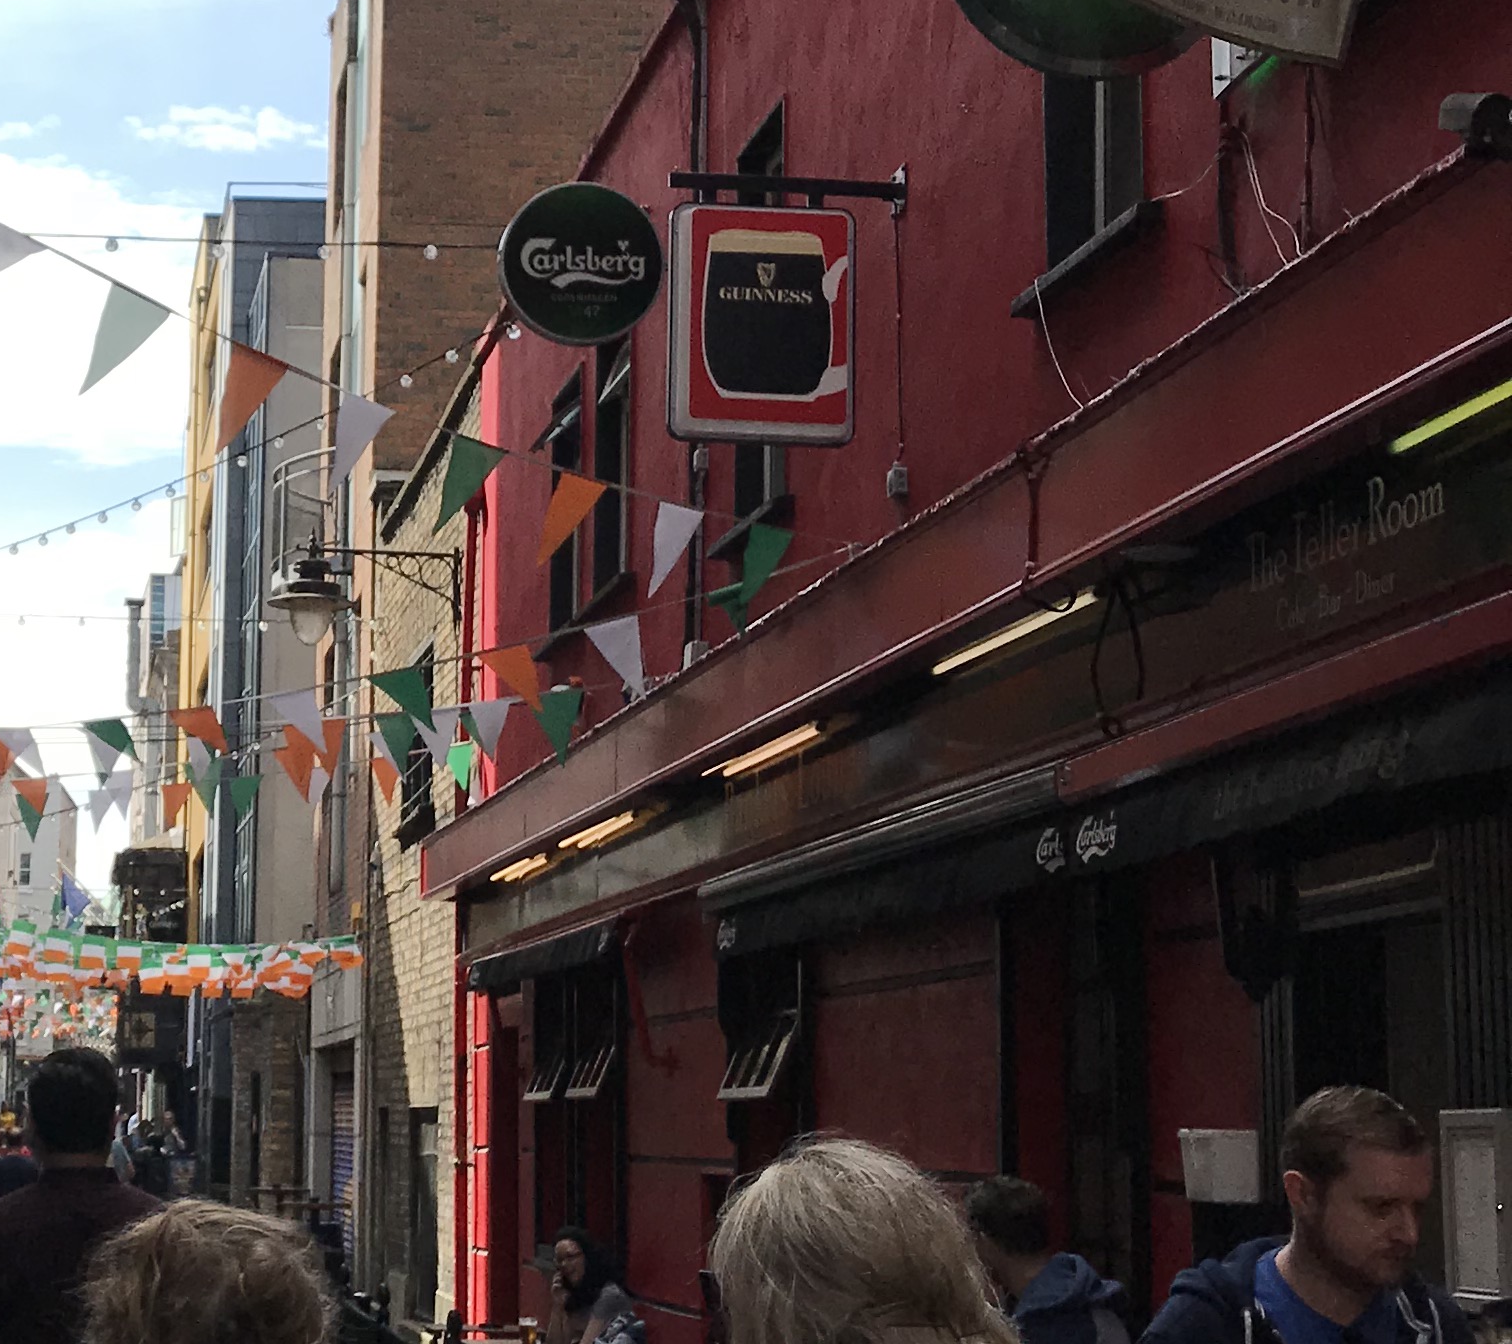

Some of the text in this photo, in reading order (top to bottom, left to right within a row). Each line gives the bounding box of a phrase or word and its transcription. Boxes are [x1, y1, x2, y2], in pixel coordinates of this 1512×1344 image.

[519, 237, 647, 288] Carlsberg
[718, 285, 814, 304] GUINNESS
[1246, 475, 1446, 592] The Teller Room
[1075, 808, 1118, 864] Carlsberg
